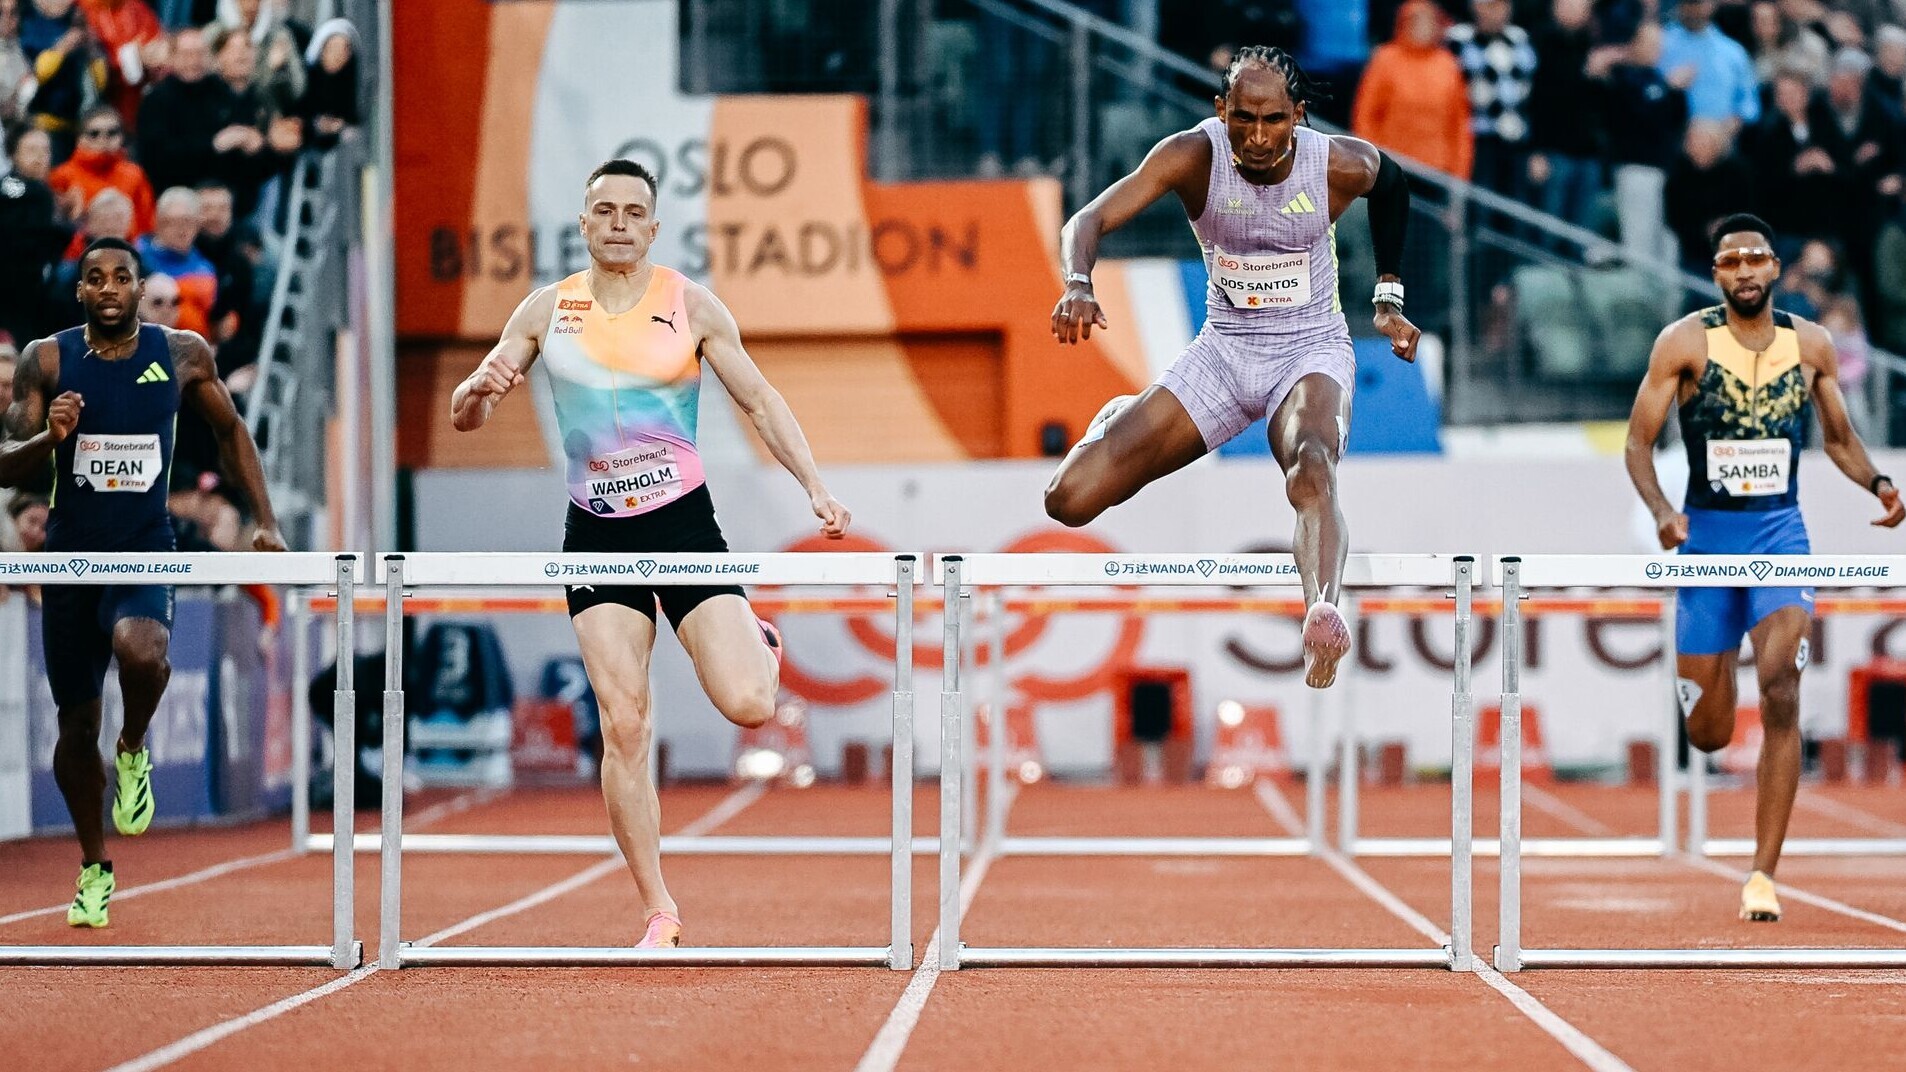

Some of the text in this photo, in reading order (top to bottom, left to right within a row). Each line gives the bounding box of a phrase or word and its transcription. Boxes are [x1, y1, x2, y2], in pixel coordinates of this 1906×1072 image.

[611, 136, 797, 196] OSLO
[429, 220, 980, 282] BISLE STADION
[1242, 258, 1303, 272] Storebrand
[1220, 276, 1299, 291] DOS SANTOS
[1263, 296, 1292, 304] EXTRA
[554, 326, 583, 334] Red Bull
[103, 441, 155, 451] Storebrand
[612, 447, 667, 469] Storebrand
[90, 460, 143, 475] DEAN
[1718, 464, 1780, 479] SAMBA
[592, 467, 673, 496] WARHOLM
[640, 490, 667, 503] EXTRA
[91, 563, 192, 574] DIAMOND LEAGUE
[658, 563, 760, 574] DIAMOND LEAGUE
[1219, 564, 1301, 574] DIAMOND LEA
[1774, 566, 1889, 577] DIAMOND LEAGUE
